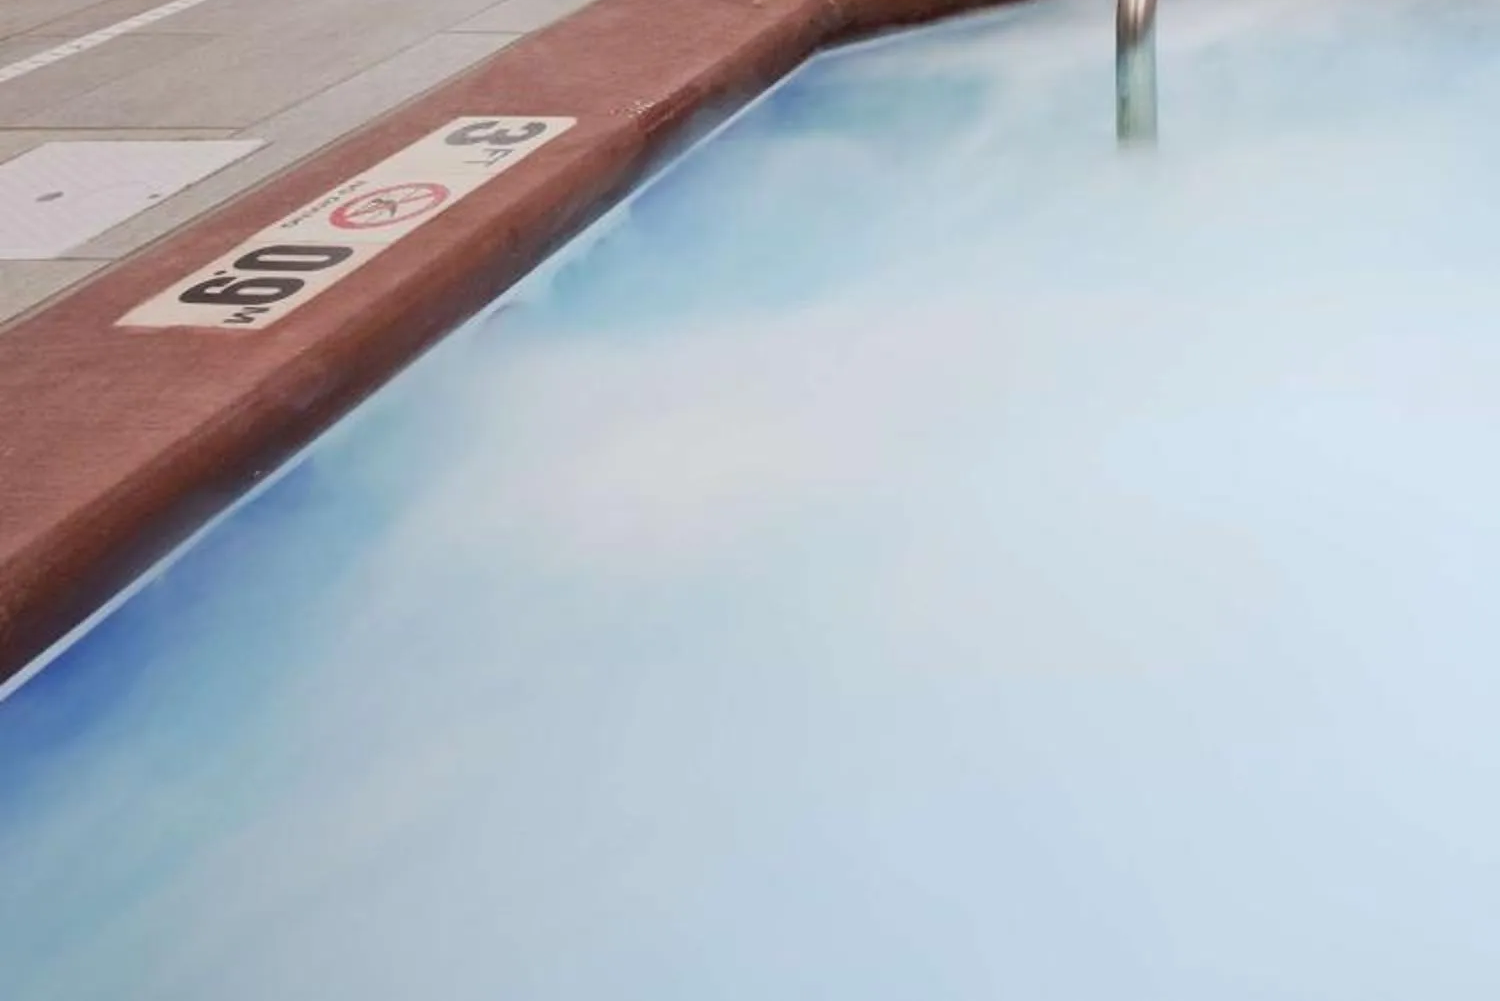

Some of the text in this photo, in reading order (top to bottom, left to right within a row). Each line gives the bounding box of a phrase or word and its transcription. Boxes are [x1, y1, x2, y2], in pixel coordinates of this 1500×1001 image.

[444, 120, 547, 167] 3 FT
[178, 245, 354, 324] 0.9 M
